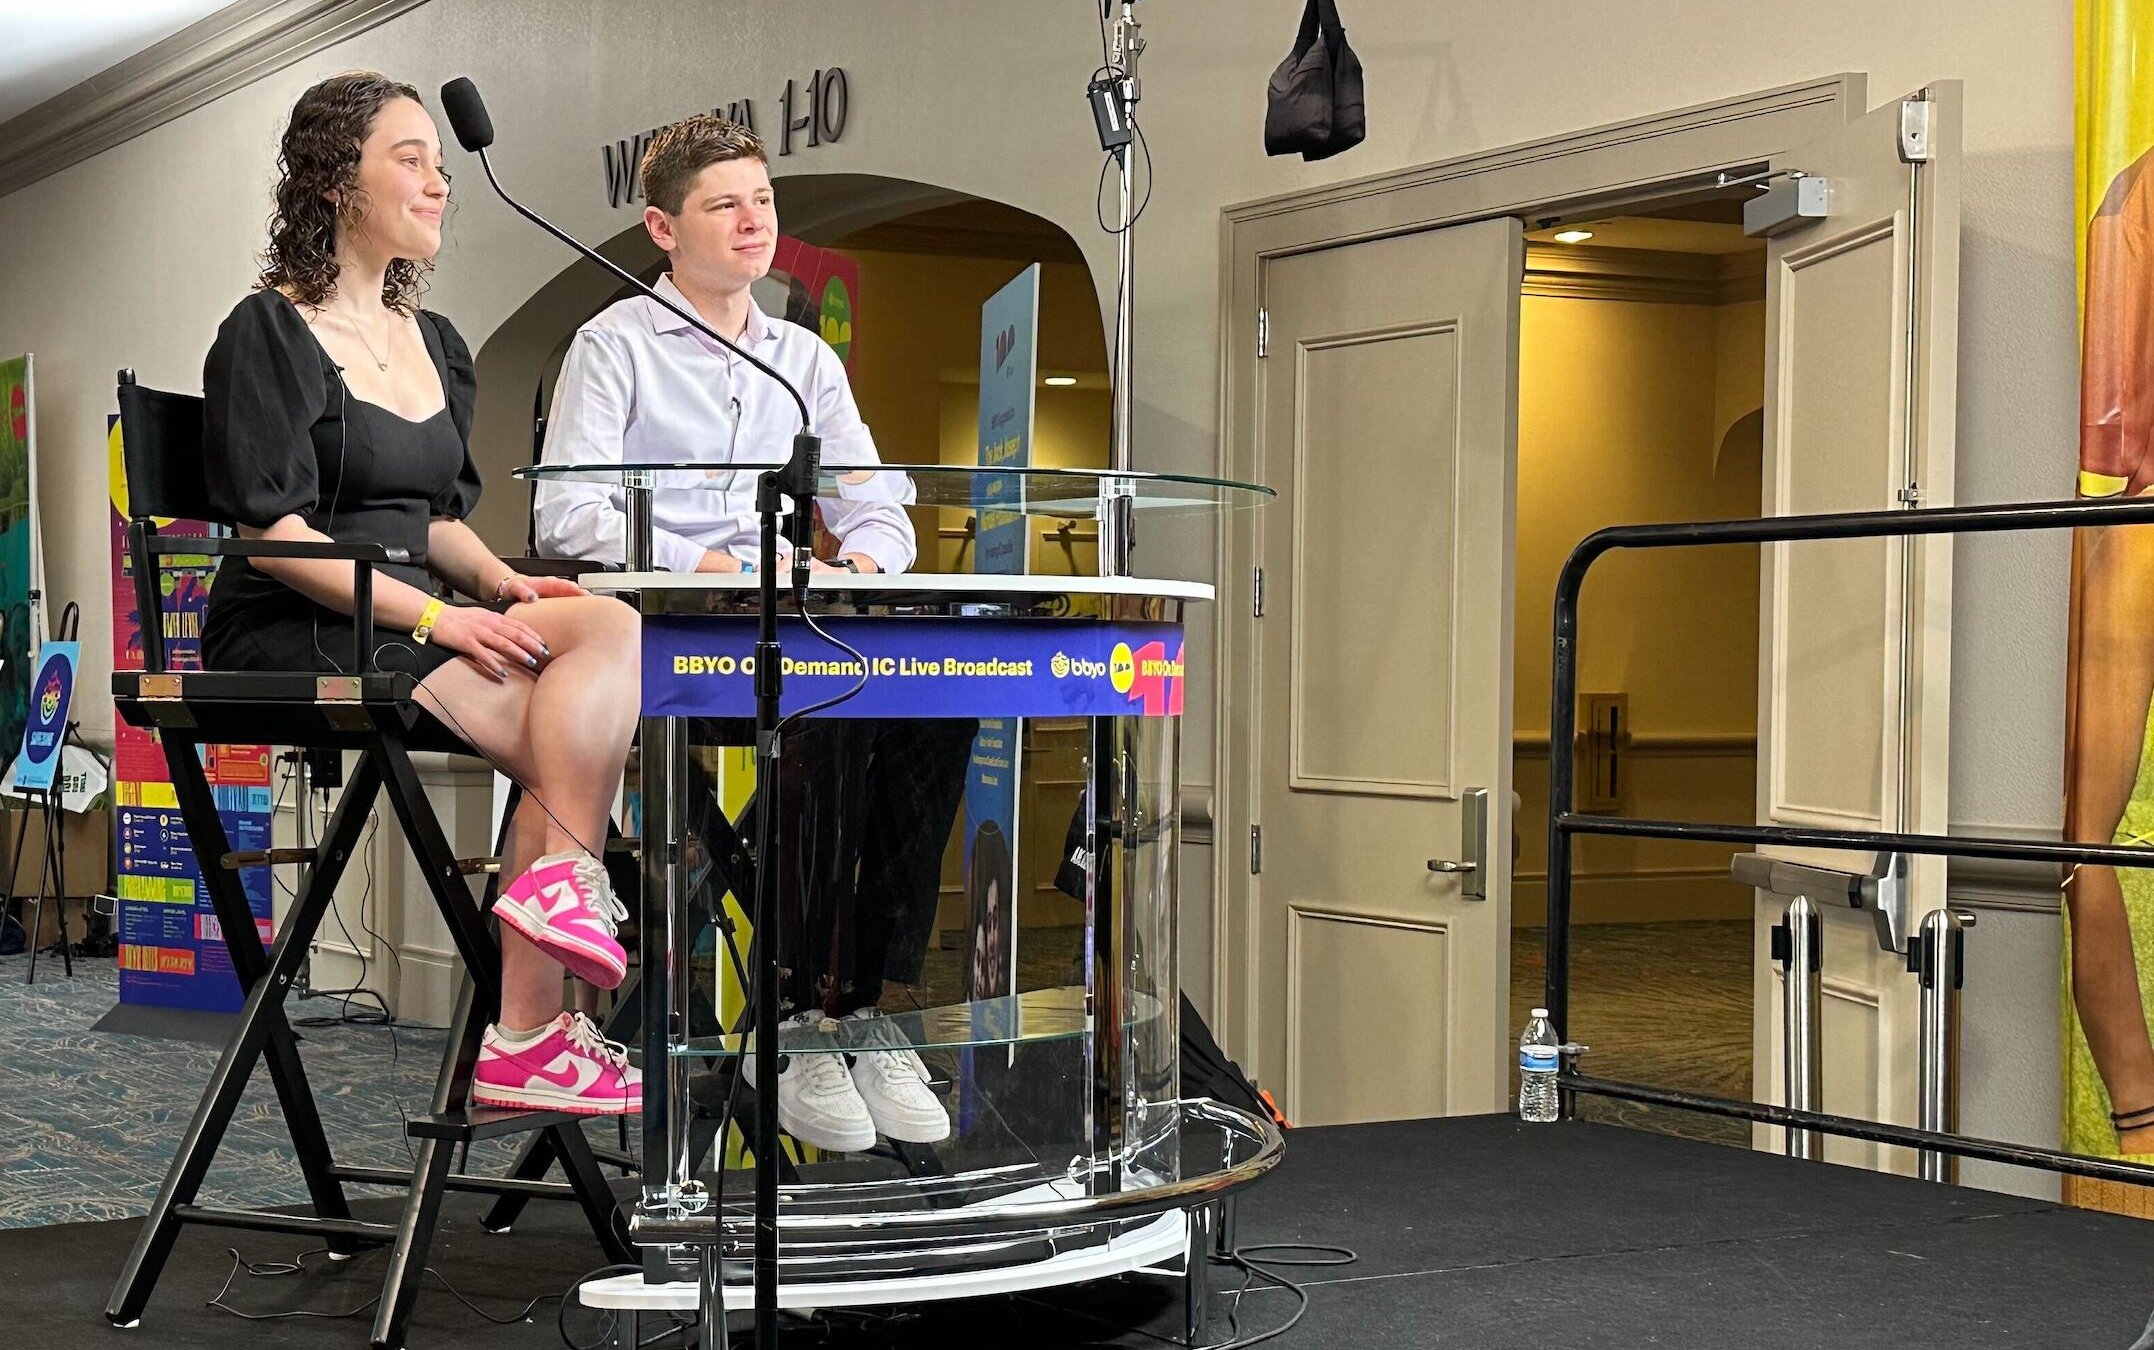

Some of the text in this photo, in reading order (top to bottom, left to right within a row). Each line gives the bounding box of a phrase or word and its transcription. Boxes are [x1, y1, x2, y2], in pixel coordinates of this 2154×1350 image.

[779, 67, 847, 156] 1-10
[673, 656, 1033, 676] BBYO O Demand IC Live Broadcast
[1071, 658, 1106, 679] bbyo
